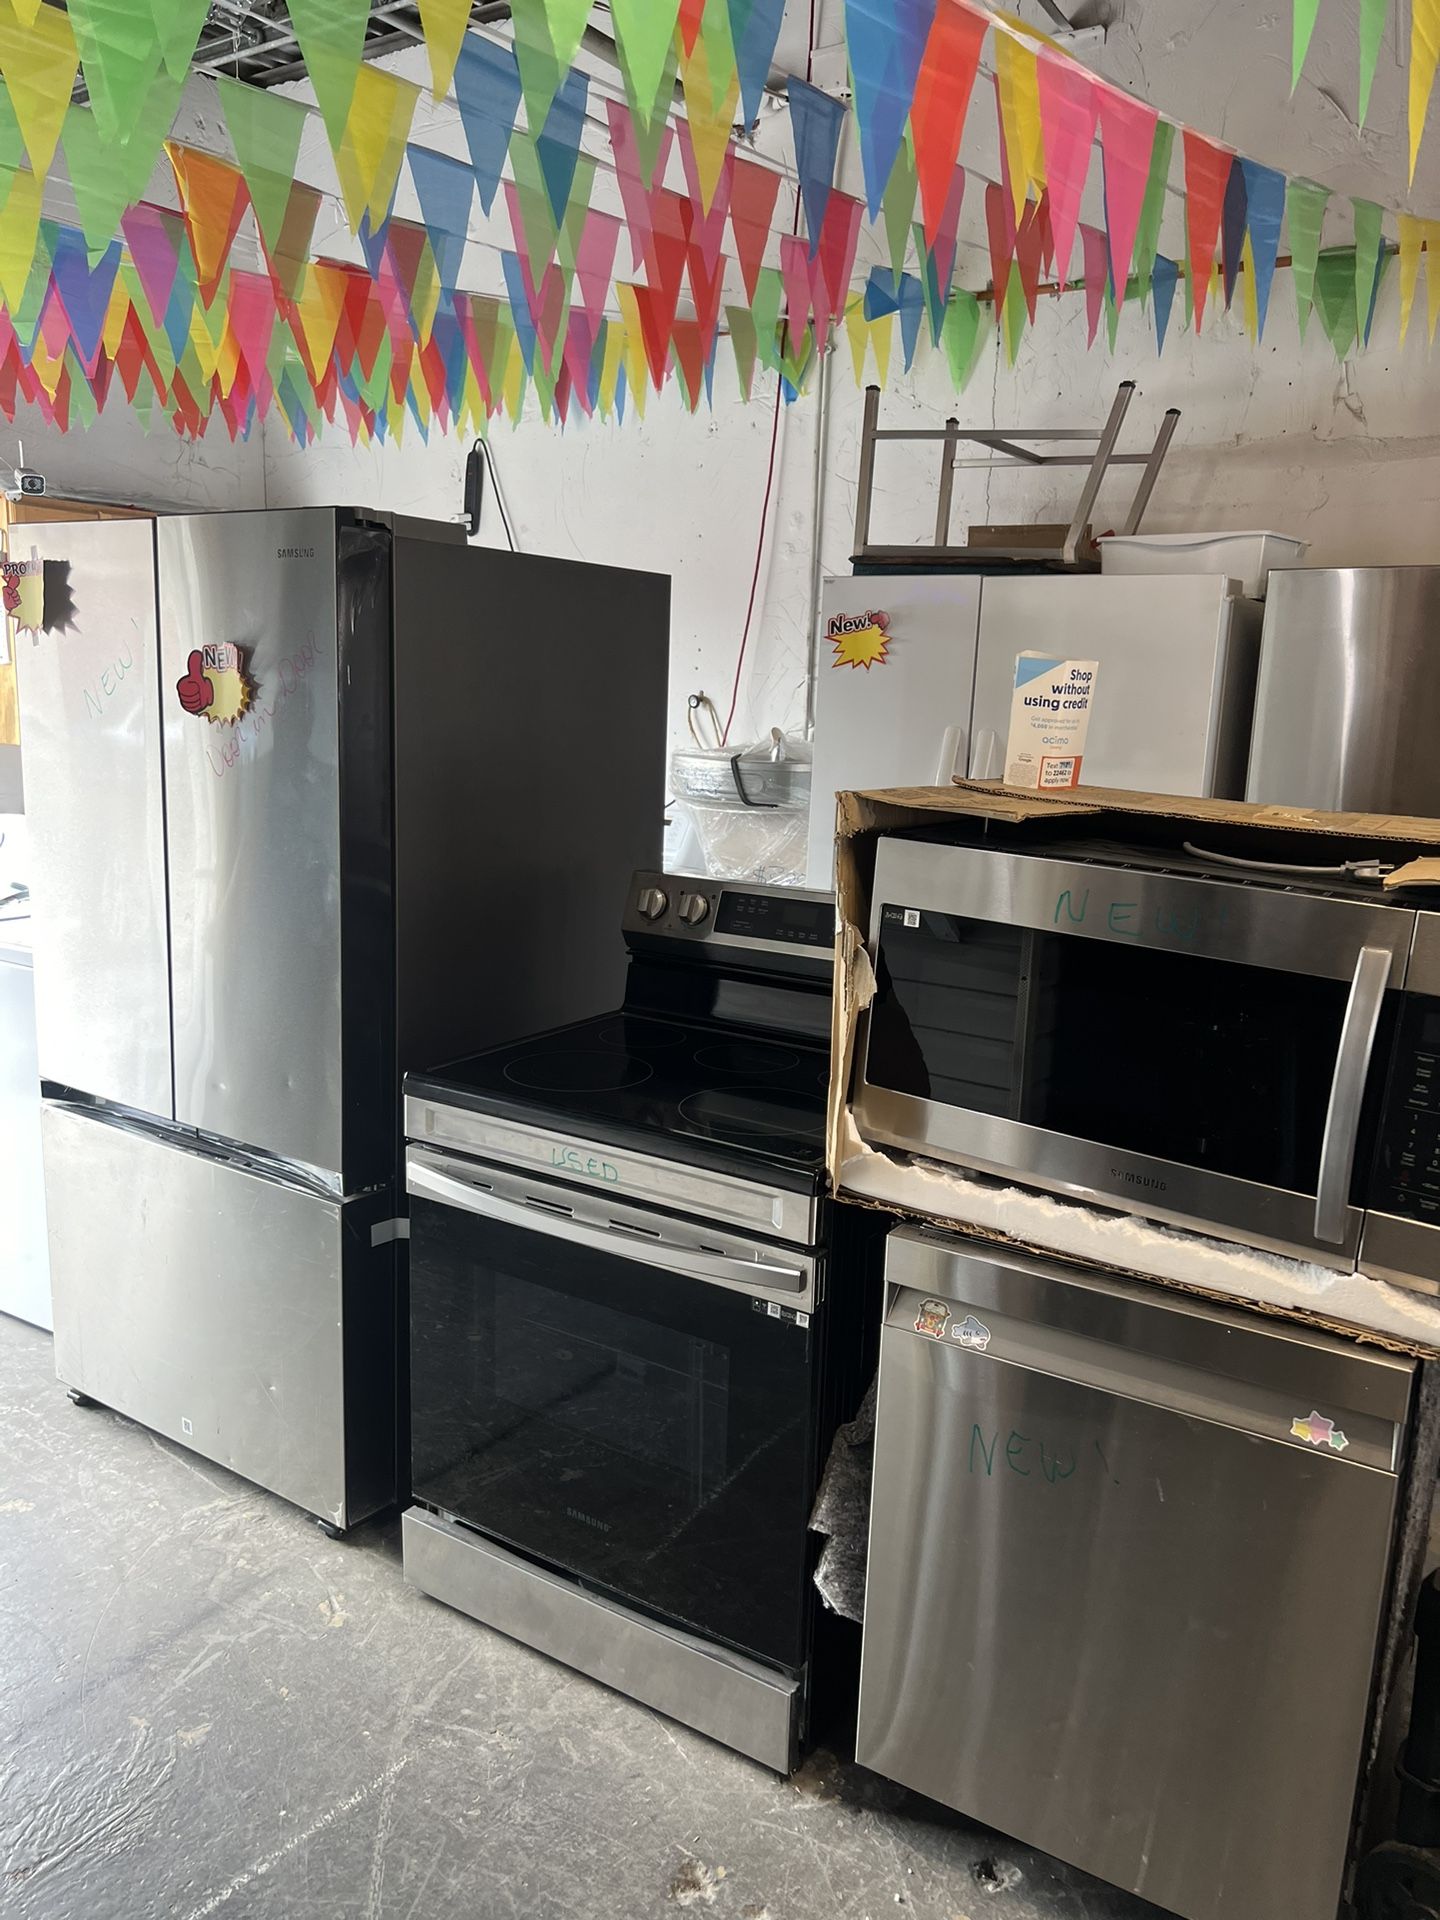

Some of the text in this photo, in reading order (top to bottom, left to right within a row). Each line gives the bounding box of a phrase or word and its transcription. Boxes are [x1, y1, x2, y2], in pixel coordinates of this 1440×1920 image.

[277, 548, 314, 559] SAMSUNG
[830, 613, 871, 634] New!
[1070, 669, 1093, 683] Shop
[1052, 684, 1090, 695] without
[1024, 696, 1088, 711] using credit
[1042, 736, 1069, 744] acima
[552, 1148, 618, 1184] USED
[1111, 1168, 1167, 1191] SAMSUNG
